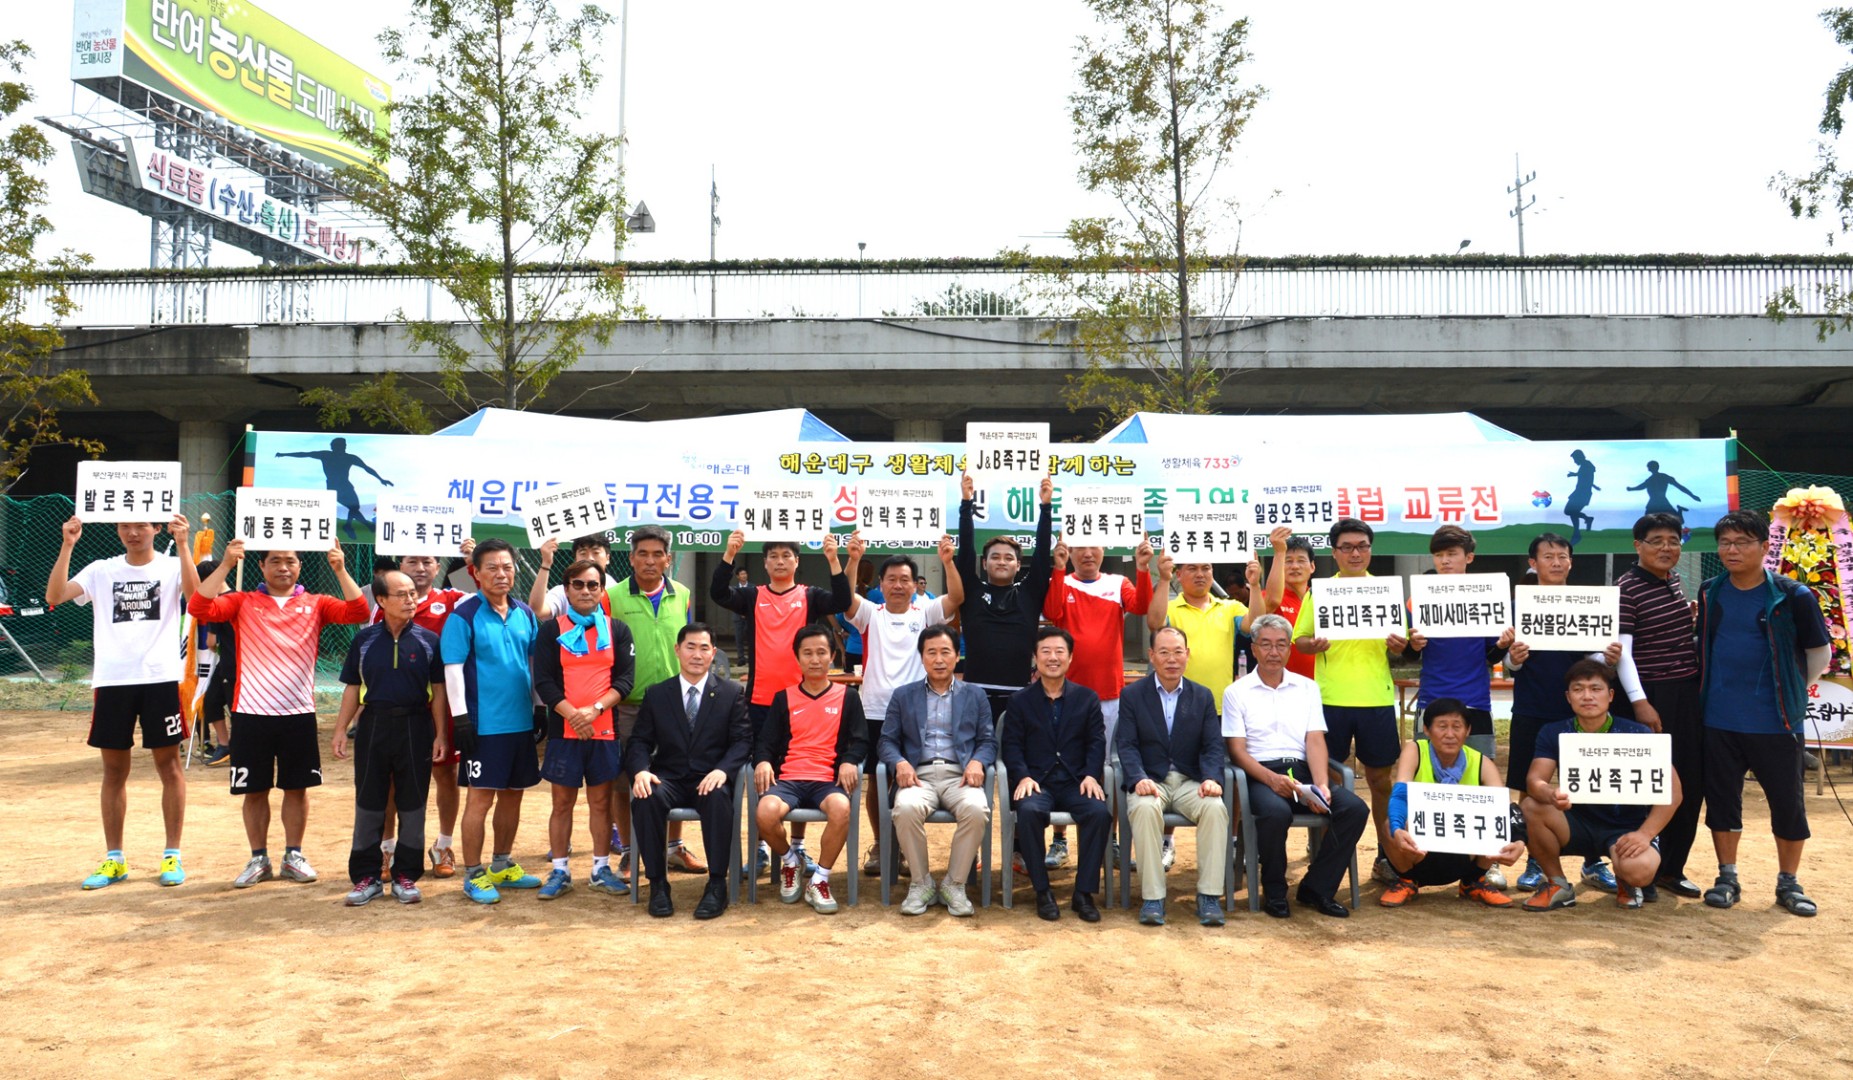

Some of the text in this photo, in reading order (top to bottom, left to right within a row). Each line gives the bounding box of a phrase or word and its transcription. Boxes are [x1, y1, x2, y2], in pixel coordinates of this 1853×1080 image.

[76, 38, 117, 53] 반여 농산물
[152, 0, 205, 64] 반여
[208, 16, 293, 111] 농산물
[80, 51, 112, 65] 도매시장
[147, 152, 206, 204] 식료품
[779, 453, 874, 475] 해운대구
[1088, 455, 1136, 476] 하는
[977, 450, 1040, 470] J&B족구단
[1161, 457, 1230, 470] 생활체육 733
[85, 490, 173, 512] 발로족구단
[1254, 501, 1333, 524] 일공오족구단
[1403, 485, 1499, 522] 교류전
[244, 517, 331, 540] 해동족구단
[531, 499, 608, 538] 위드족구단
[744, 508, 824, 531] 억새족구단
[862, 506, 940, 529] 안락족구회
[1065, 514, 1142, 536] 장산족구단
[383, 522, 463, 545] 마~족구단
[677, 532, 721, 544] 10:00
[1169, 530, 1248, 553] 송주족구회
[121, 600, 151, 611] AROUND
[1318, 604, 1402, 629] 울타리족구회
[1419, 602, 1505, 627] 재미사마족구단
[1521, 613, 1613, 637] 풍산홀딩스족구단
[164, 716, 182, 736] 22
[1567, 768, 1664, 794] 풍산족구단
[1413, 810, 1507, 842] 센텀족구회
